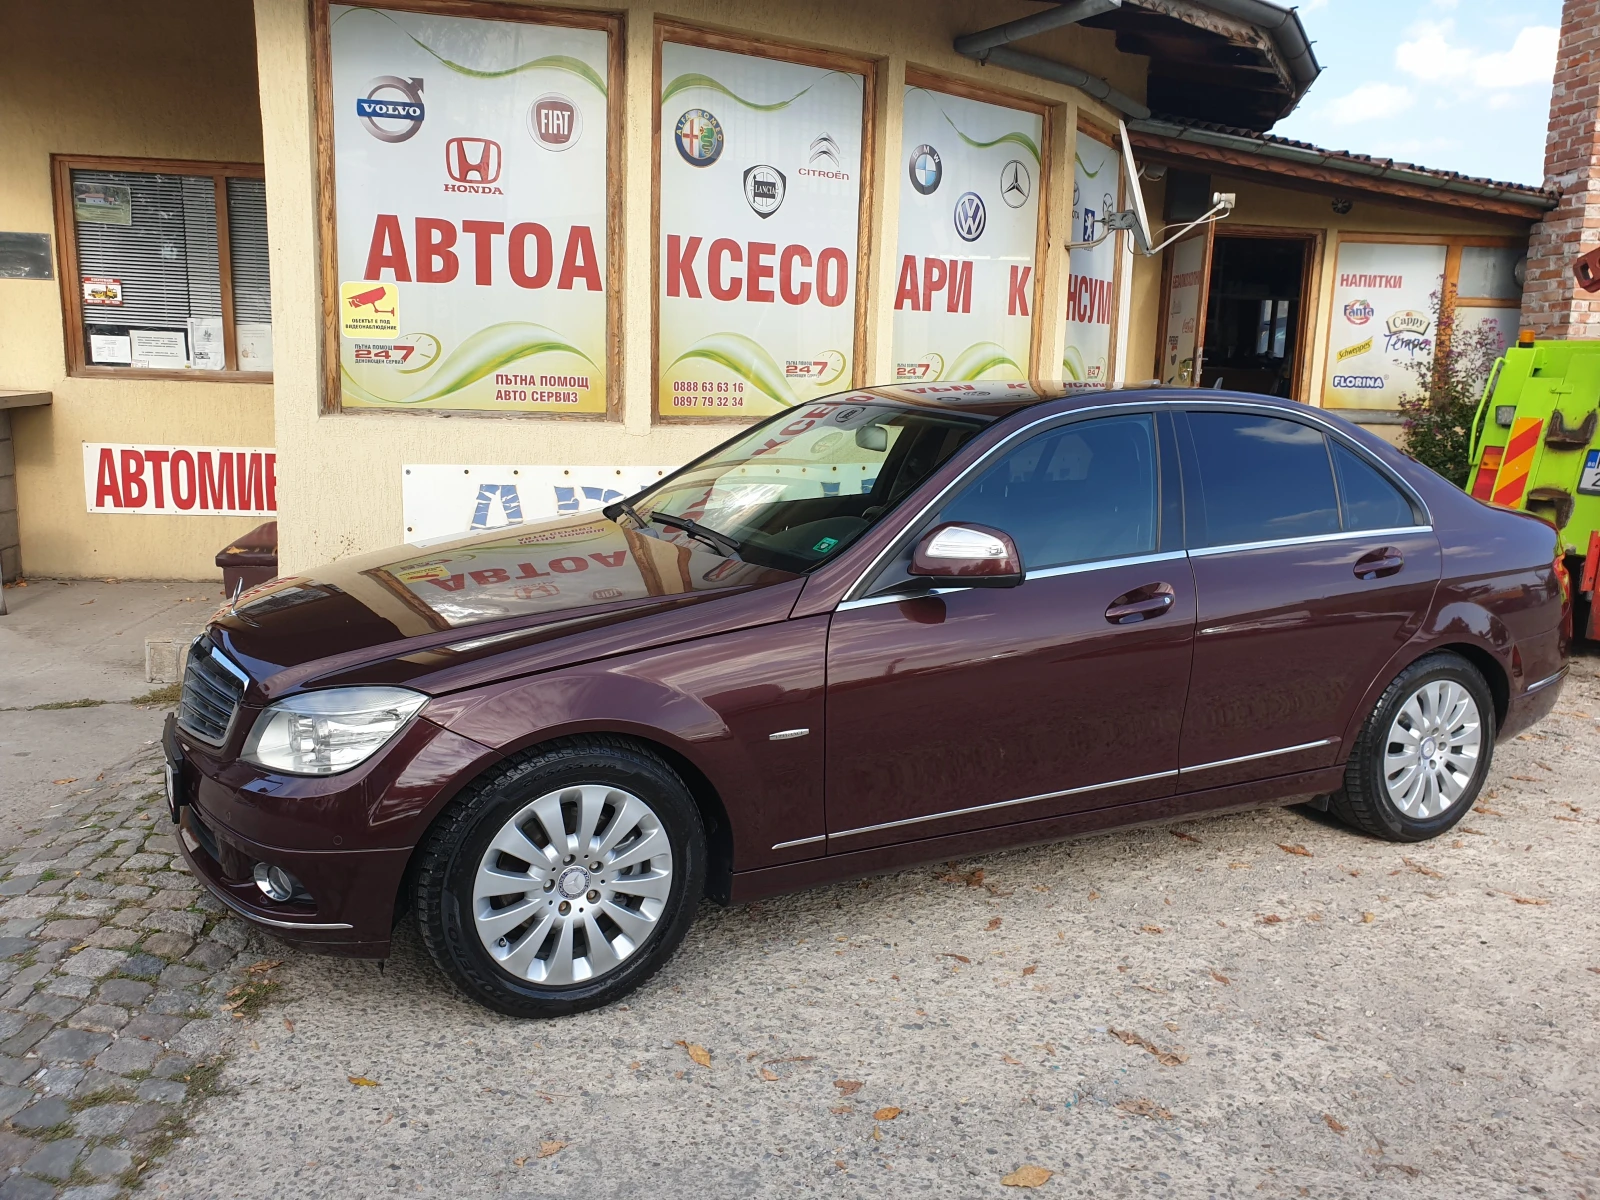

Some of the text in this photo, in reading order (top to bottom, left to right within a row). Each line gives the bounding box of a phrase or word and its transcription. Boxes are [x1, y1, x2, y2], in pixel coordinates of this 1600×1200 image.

[361, 102, 421, 117] VOLVO
[541, 109, 570, 135] FIAT
[676, 111, 722, 141] ALFA ROMEO
[912, 145, 939, 163] BMW
[444, 183, 503, 195] HONDA
[755, 184, 776, 195] LANCIA
[363, 213, 603, 292] АВТОА
[666, 234, 849, 308] КСЕСО
[894, 254, 1032, 317] АРИ К
[1340, 274, 1402, 288] НАПИТКИ
[1066, 273, 1112, 325] НСУМ
[1344, 304, 1374, 317] Fanta
[1393, 316, 1425, 328] Cappy
[1338, 341, 1371, 360] Schweppes
[496, 374, 589, 390] ПЪТНА ПОМОЩ
[673, 382, 744, 392] 0888 63 63 16
[1334, 375, 1384, 388] FLORINA
[496, 390, 578, 402] АВТО СЕРВИЗ
[673, 397, 743, 406] 0897 79 32 34
